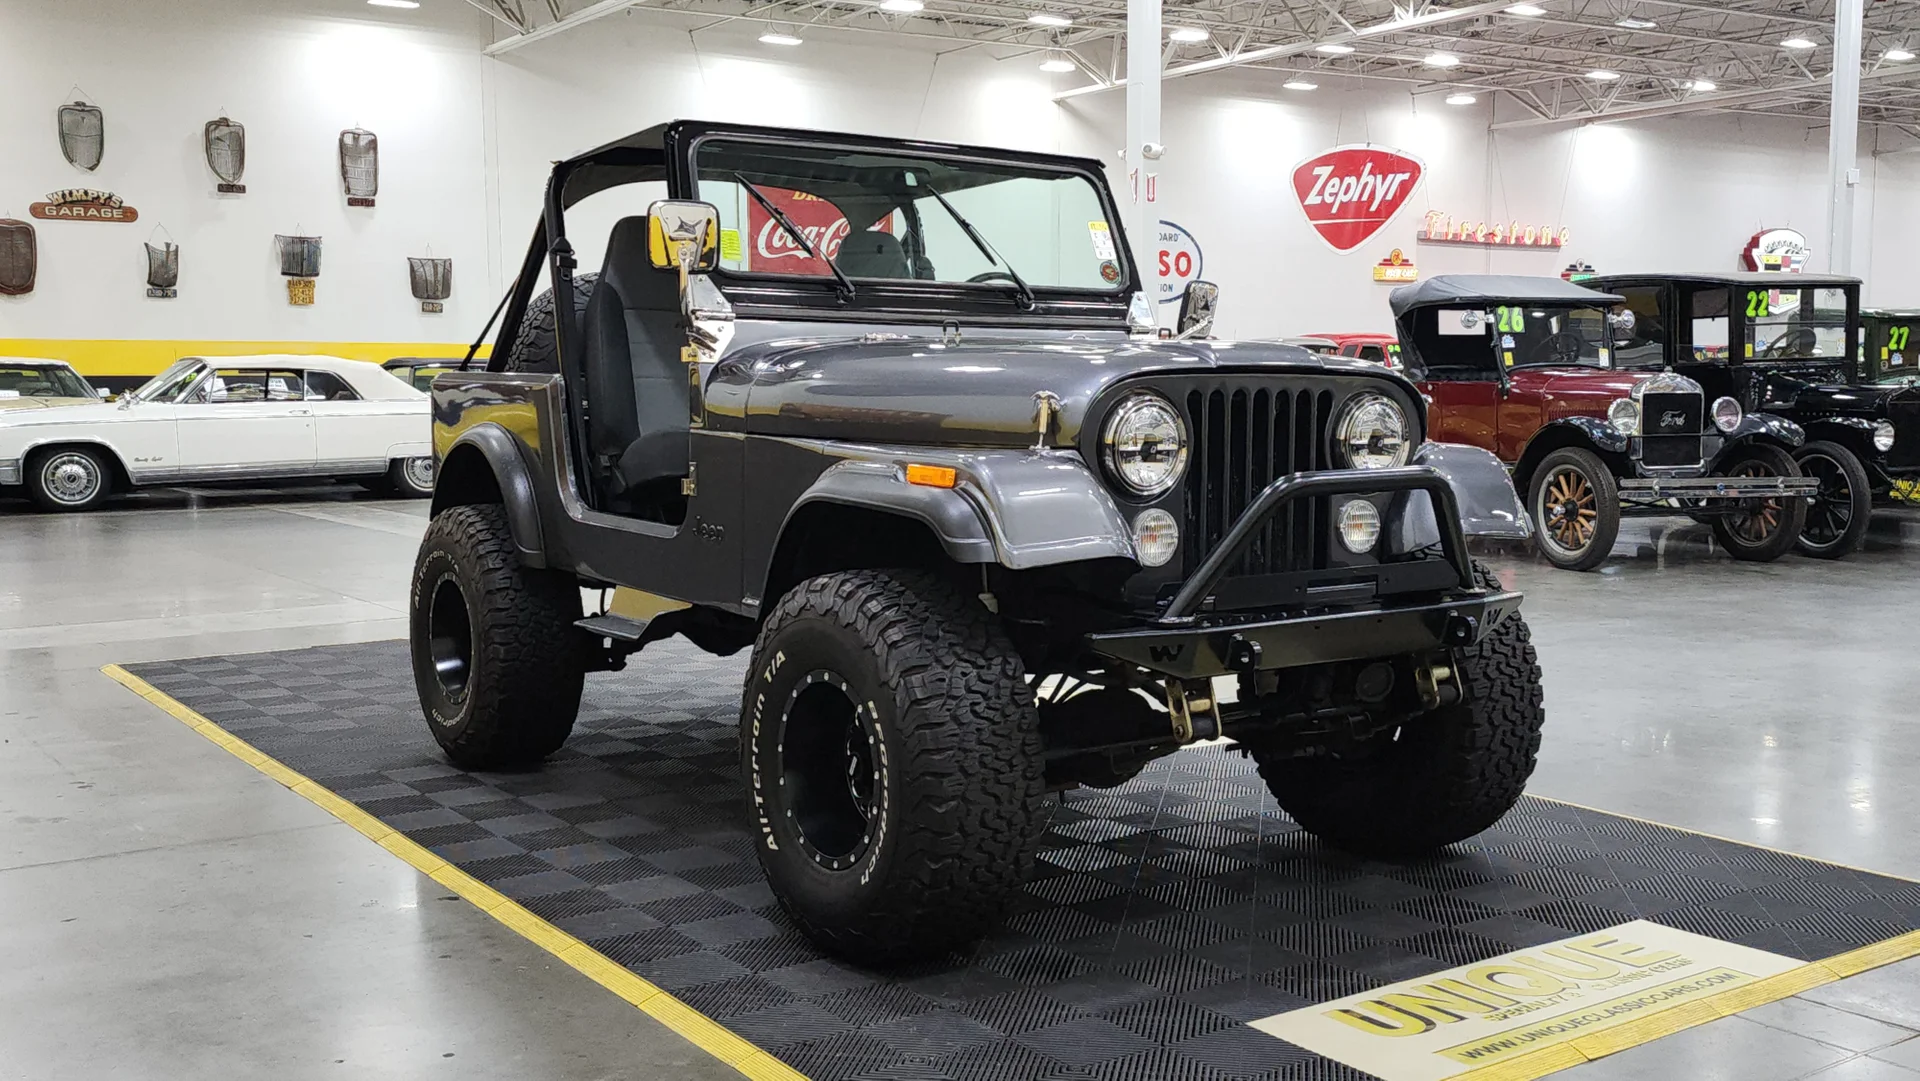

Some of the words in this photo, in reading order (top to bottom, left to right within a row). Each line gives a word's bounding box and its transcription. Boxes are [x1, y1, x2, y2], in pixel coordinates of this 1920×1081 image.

[46, 188, 123, 209] WIMPY'S
[1303, 162, 1411, 214] Zephyr
[45, 206, 123, 218] GARAGE
[1425, 210, 1570, 246] Firestone
[1158, 250, 1192, 278] SO
[1745, 290, 1769, 317] 22
[1497, 305, 1525, 333] 26
[1888, 325, 1910, 351] 27
[1660, 410, 1686, 427] Ford
[691, 515, 725, 542] Jeep
[752, 693, 780, 851] All-Terrain
[860, 700, 889, 886] BFGoodrich
[1321, 934, 1682, 1039] UNIQUE
[1457, 972, 1741, 1060] WWW.UNIQUECLASSICCARS.COM
